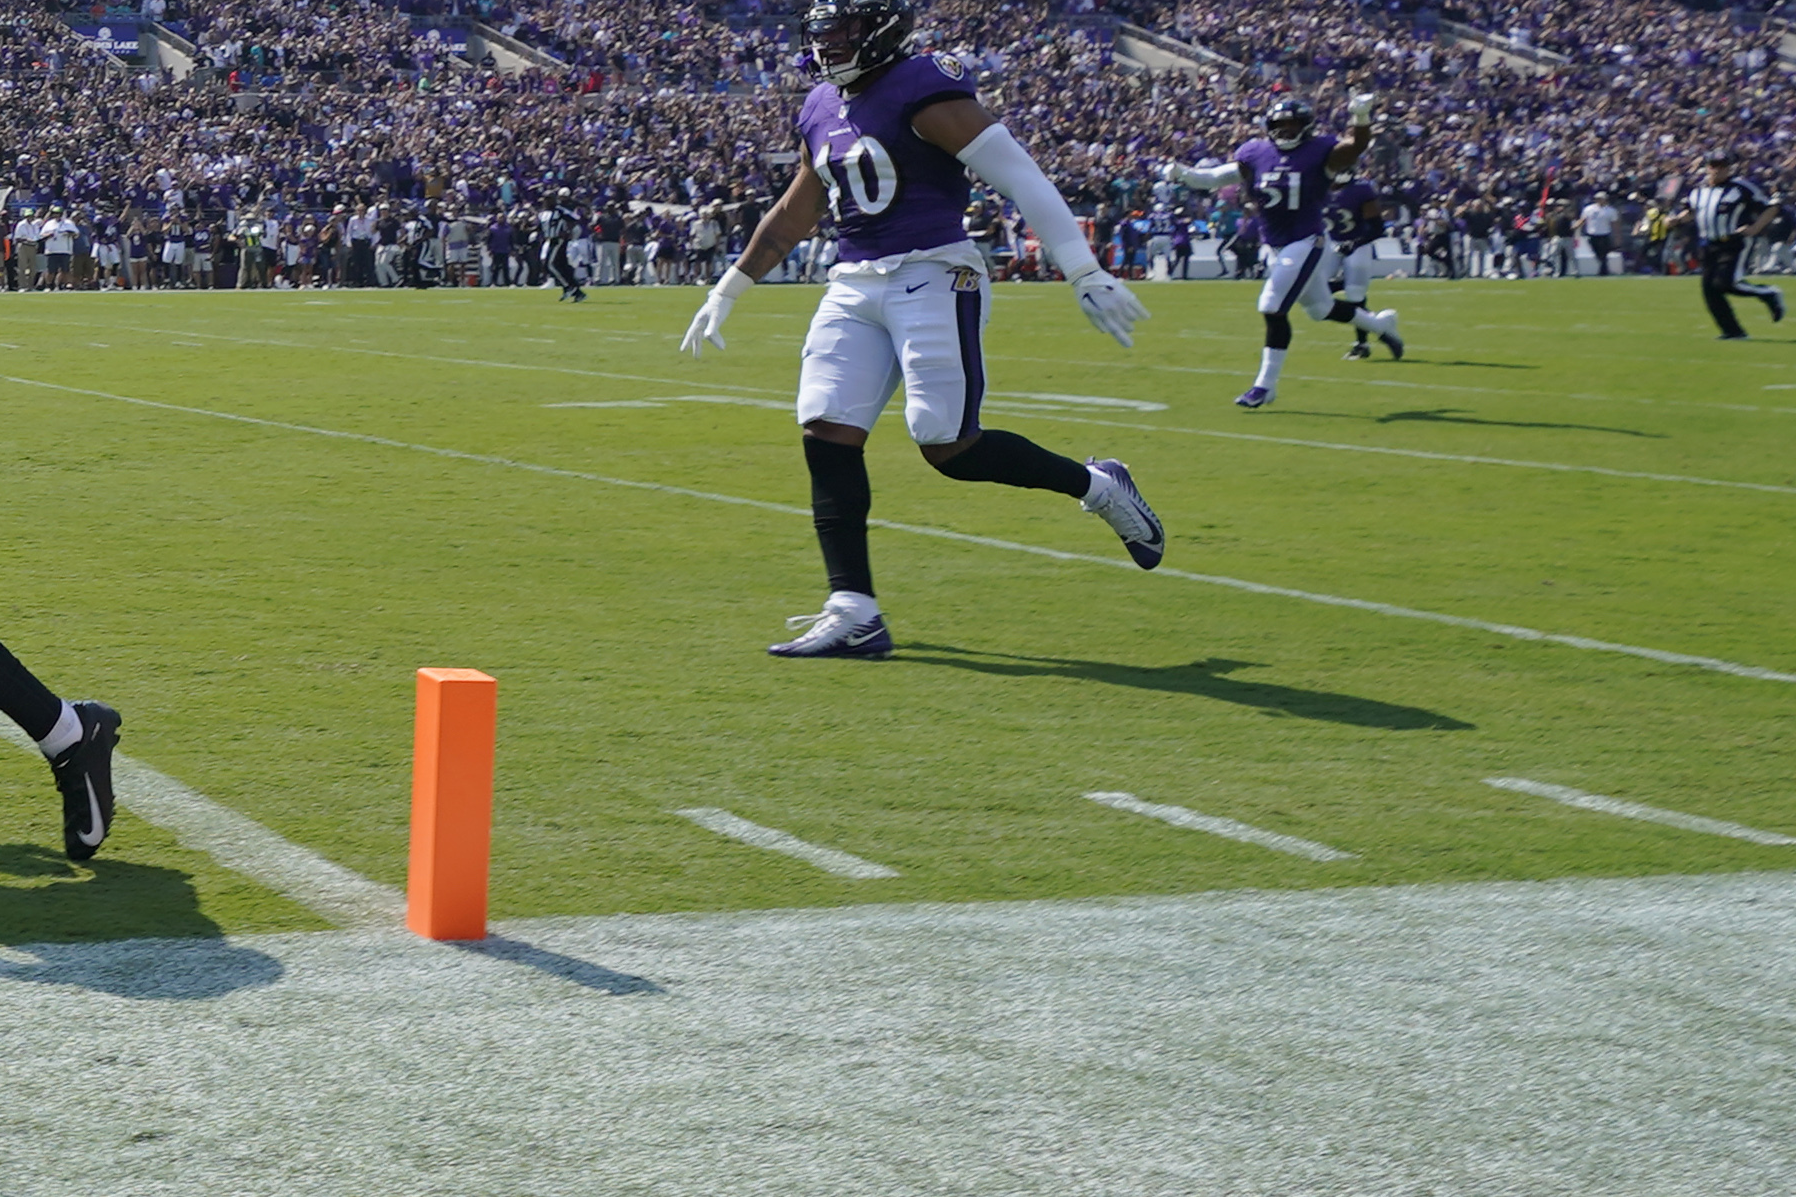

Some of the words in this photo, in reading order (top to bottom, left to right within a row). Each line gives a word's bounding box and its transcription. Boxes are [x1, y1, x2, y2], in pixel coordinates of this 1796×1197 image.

[113, 41, 139, 50] LAKE
[814, 135, 898, 222] 40
[1260, 172, 1301, 210] 51
